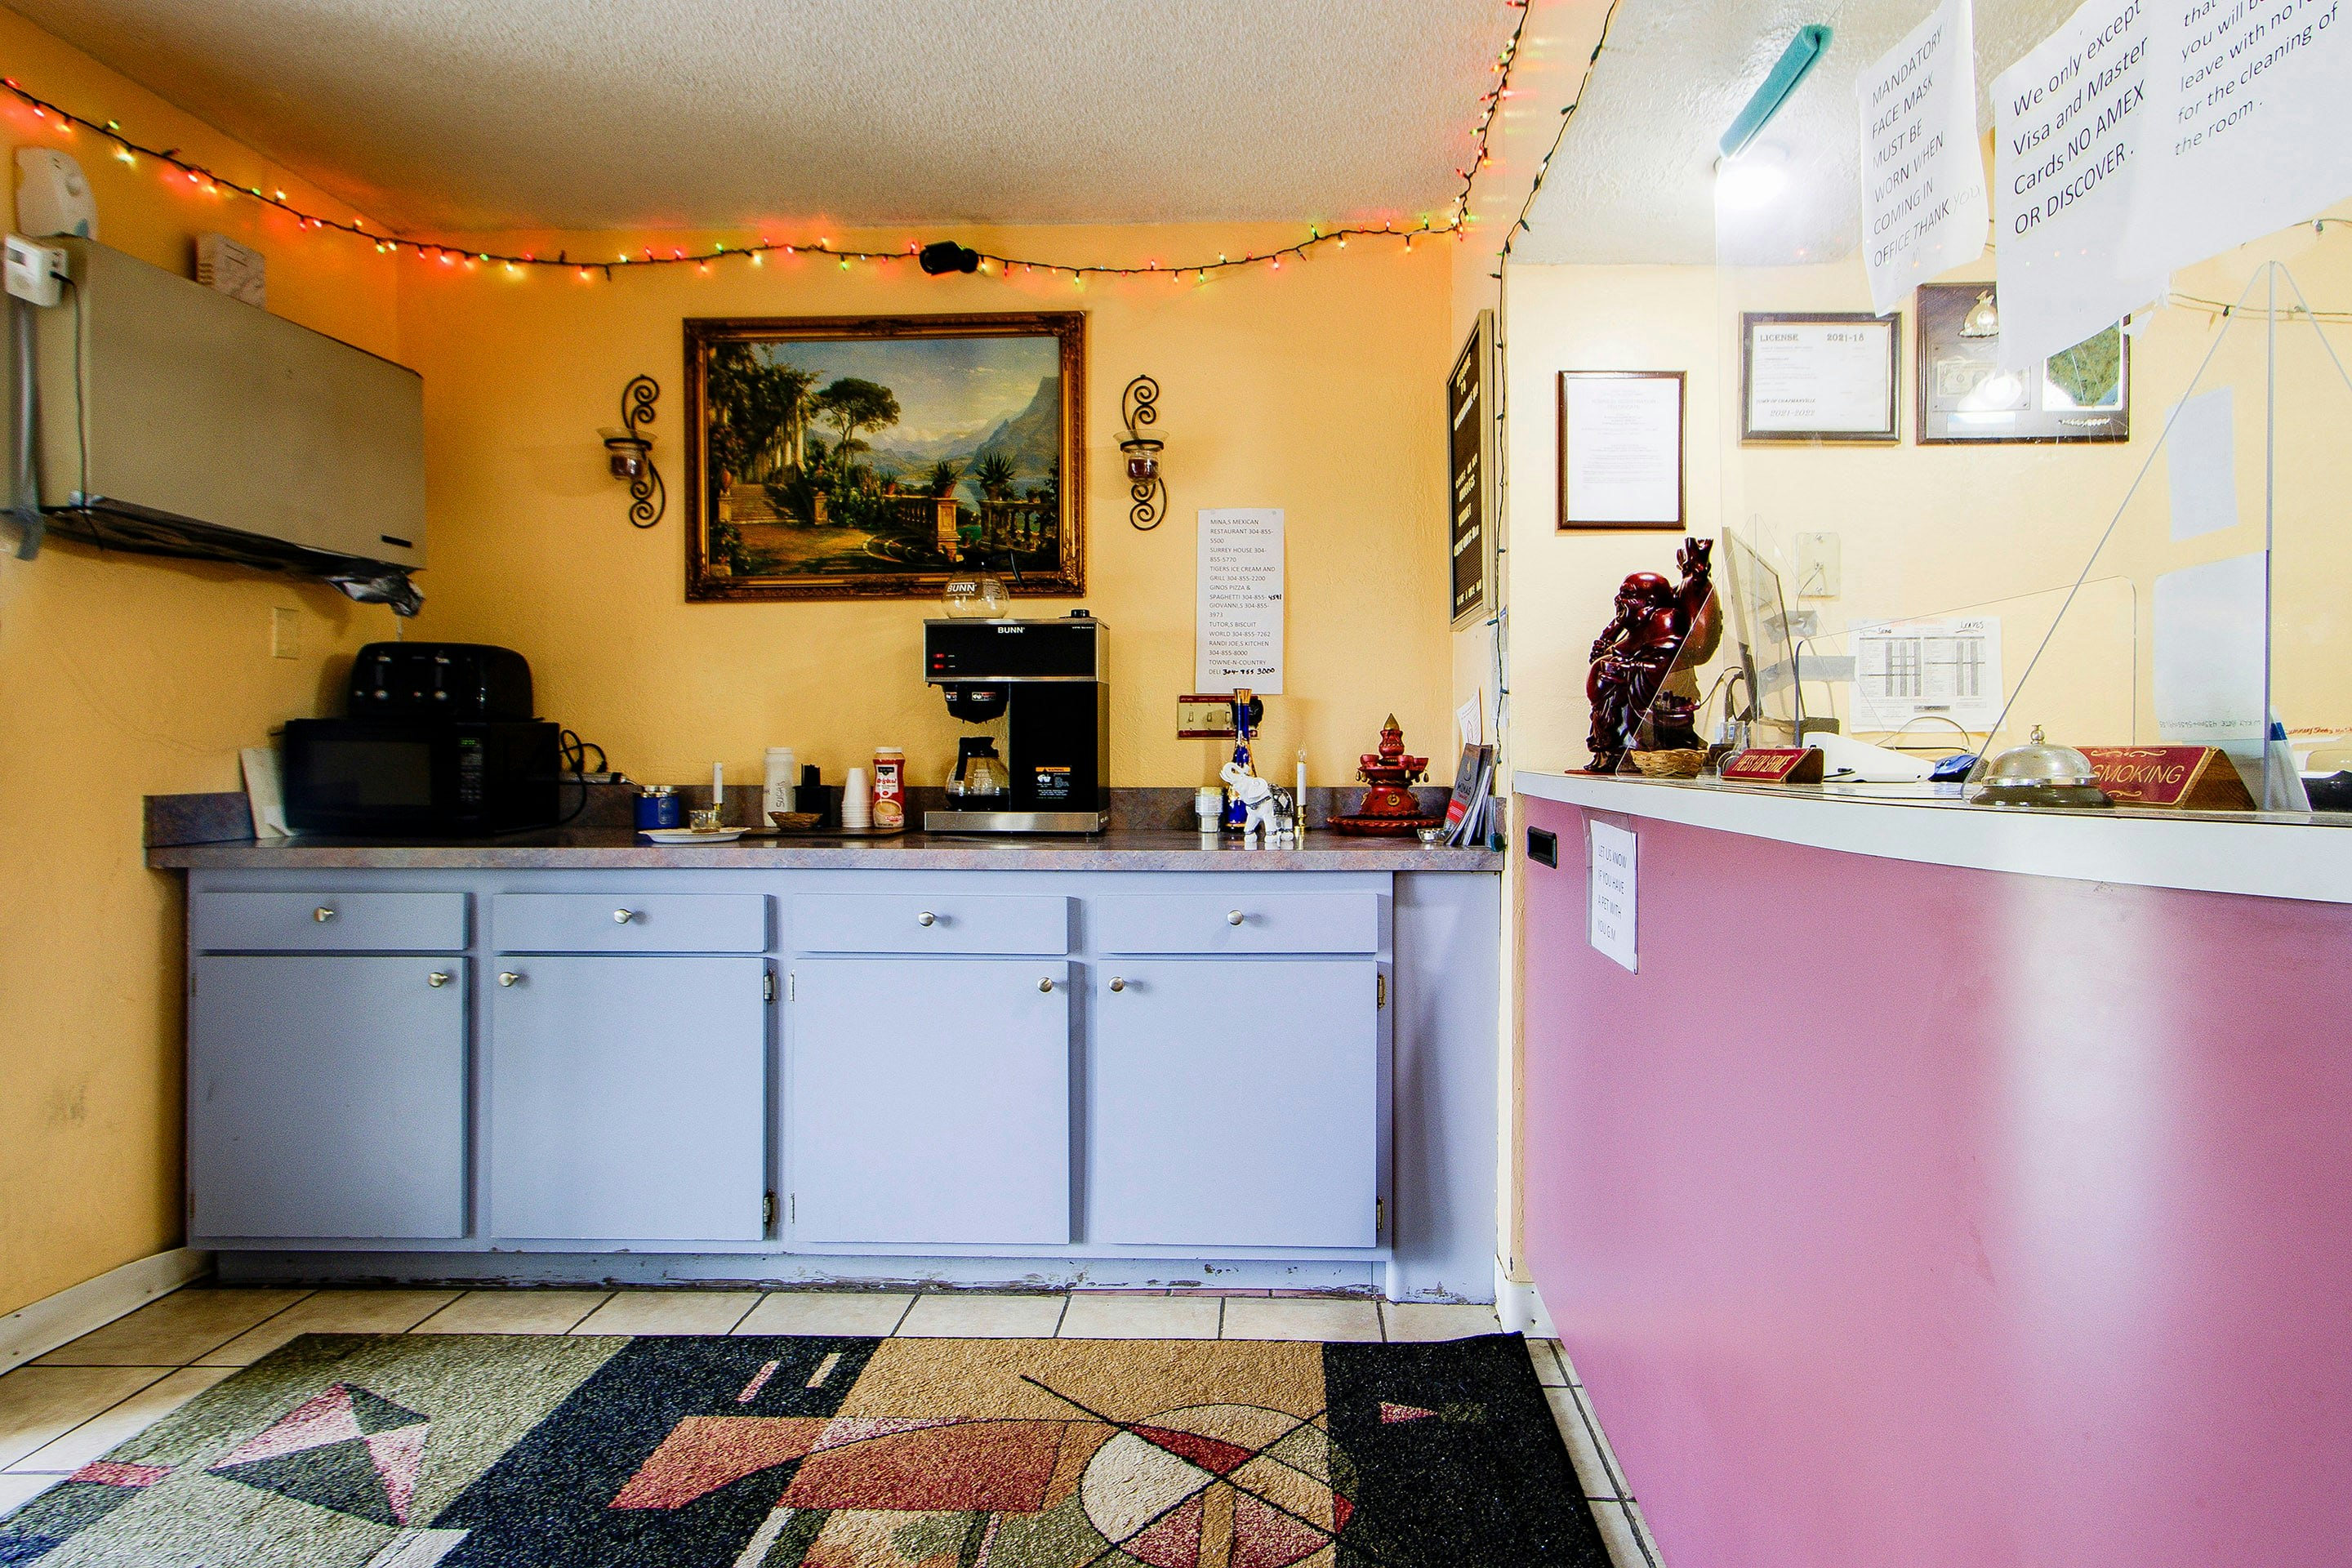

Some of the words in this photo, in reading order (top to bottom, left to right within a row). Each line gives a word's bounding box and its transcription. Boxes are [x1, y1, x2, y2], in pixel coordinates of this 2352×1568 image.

[1873, 24, 1942, 108] MANDATORY
[2014, 89, 2043, 117] We
[2049, 53, 2082, 93] only
[2087, 0, 2141, 60] except
[2179, 100, 2203, 123] for
[2207, 81, 2235, 106] the
[2240, 24, 2313, 84] cleaning
[2319, 1, 2338, 29] of
[2180, 56, 2224, 92] leave
[2230, 24, 2265, 59] with
[2271, 5, 2292, 29] no
[2181, 31, 2212, 63] you
[2217, 2, 2243, 34] will
[1873, 104, 1900, 140] FACE
[1904, 70, 1933, 114] MASK
[2013, 123, 2050, 155] Visa
[2056, 88, 2082, 130] and
[2088, 37, 2147, 101] Master
[2176, 132, 2203, 156] the
[2208, 100, 2253, 137] room
[1873, 131, 1905, 170] MUST
[1909, 118, 1922, 143] BE
[1874, 164, 1909, 203] WORN
[1913, 131, 1943, 172] WHEN
[2015, 154, 2063, 195] Cards
[2068, 127, 2091, 162] NO
[2096, 78, 2145, 139] AMEX
[1874, 189, 1920, 235] COMING
[1923, 176, 1933, 200] IN
[2015, 206, 2040, 234] OR
[2047, 143, 2124, 217] DISCOVER
[1874, 229, 1910, 267] OFFICE
[1913, 198, 1949, 240] THANK
[1760, 333, 1799, 341] LICENSE
[947, 584, 975, 592] BUNN
[2092, 764, 2185, 784] SMOKING
